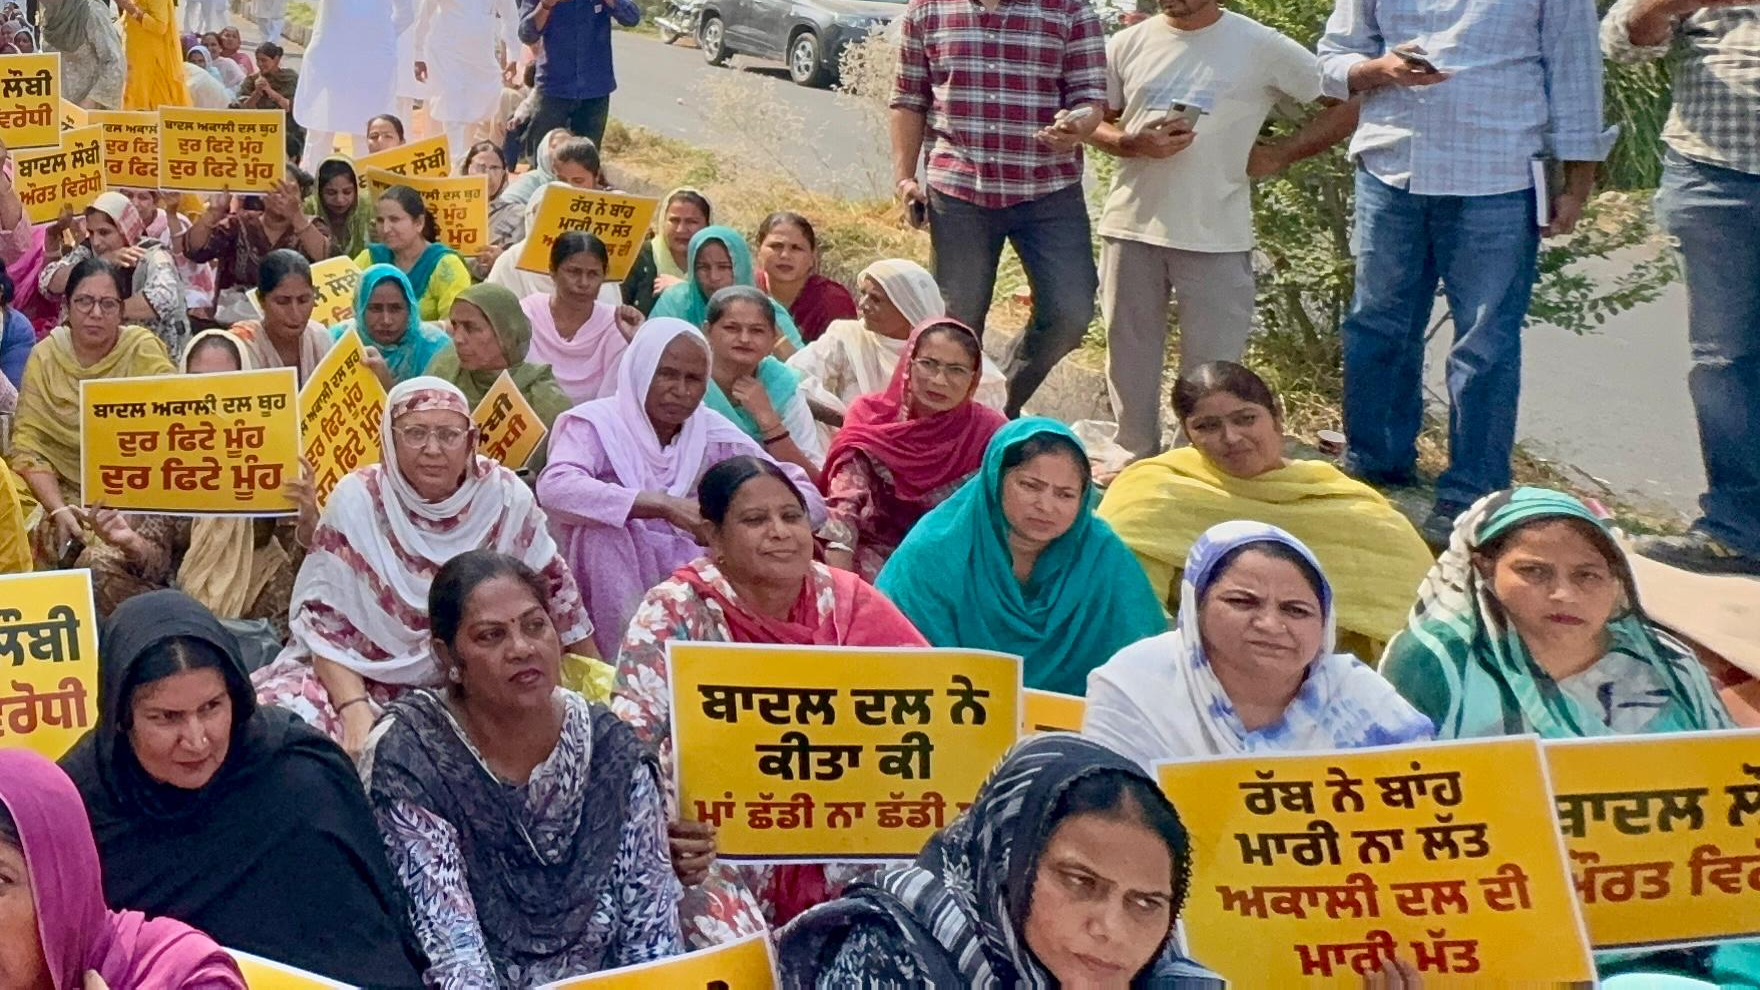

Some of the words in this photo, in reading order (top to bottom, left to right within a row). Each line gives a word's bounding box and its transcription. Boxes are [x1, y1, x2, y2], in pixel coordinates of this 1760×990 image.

[3, 69, 52, 98] ਲੌਬੀ
[93, 402, 146, 418] ਬਾਦਲ
[152, 394, 217, 416] ਅਕਾਲੀ
[222, 397, 252, 413] ਦਲ
[167, 421, 217, 451] ਫਿਟੇ
[224, 419, 265, 458] ਮੂੰਹ
[161, 457, 222, 490] ਫਿਟੇ
[231, 454, 283, 500] ਮੂੰਹ
[698, 684, 837, 725] ਬਾਦਲ
[850, 688, 934, 726] ਦਲ
[947, 674, 990, 726] ਨੇ
[755, 732, 862, 781] ਕੀਤਾ
[876, 732, 934, 781] ਕੀ
[747, 792, 814, 829] ਛੱਡੀ
[826, 801, 866, 828] ਨਾ
[876, 792, 944, 828] ਛੱਡੀ
[1240, 771, 1316, 815] ਰੱਬ
[1326, 767, 1365, 813] ਨੇ
[1376, 762, 1463, 809] ਬਾਂਹ
[1235, 821, 1341, 866] ਮਾਰੀ
[1351, 830, 1405, 864] ਨਾ
[1416, 814, 1489, 860] ਲੱਤ
[1217, 873, 1379, 919] ਅਕਾਲੀ
[1394, 879, 1470, 916] ਦਲ
[1478, 864, 1533, 911] ਦੀ
[1412, 931, 1481, 974] ਮੱਤ
